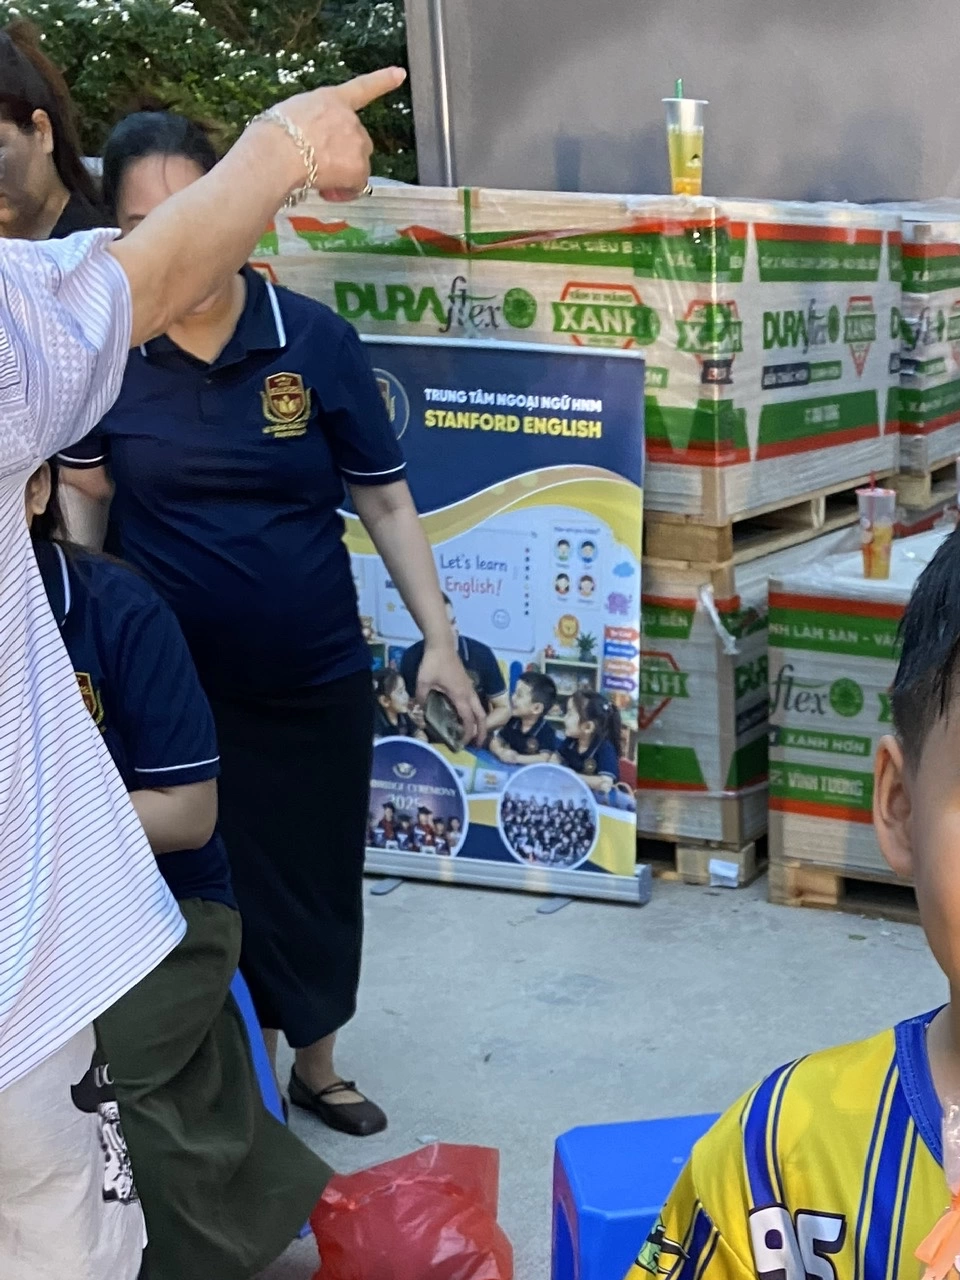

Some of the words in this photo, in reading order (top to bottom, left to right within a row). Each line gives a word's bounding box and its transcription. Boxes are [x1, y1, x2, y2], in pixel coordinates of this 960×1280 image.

[424, 388, 468, 403] TRUNG
[469, 388, 495, 406] TÂM
[496, 392, 539, 411] NGOẠI
[540, 394, 572, 411] NGỮ
[572, 399, 603, 413] HNM
[425, 409, 521, 433] STANFORD
[523, 416, 602, 439] ENGLISH
[440, 552, 472, 571] Let's
[476, 555, 508, 572] learn
[444, 575, 503, 600] English!
[786, 733, 829, 750] XANH
